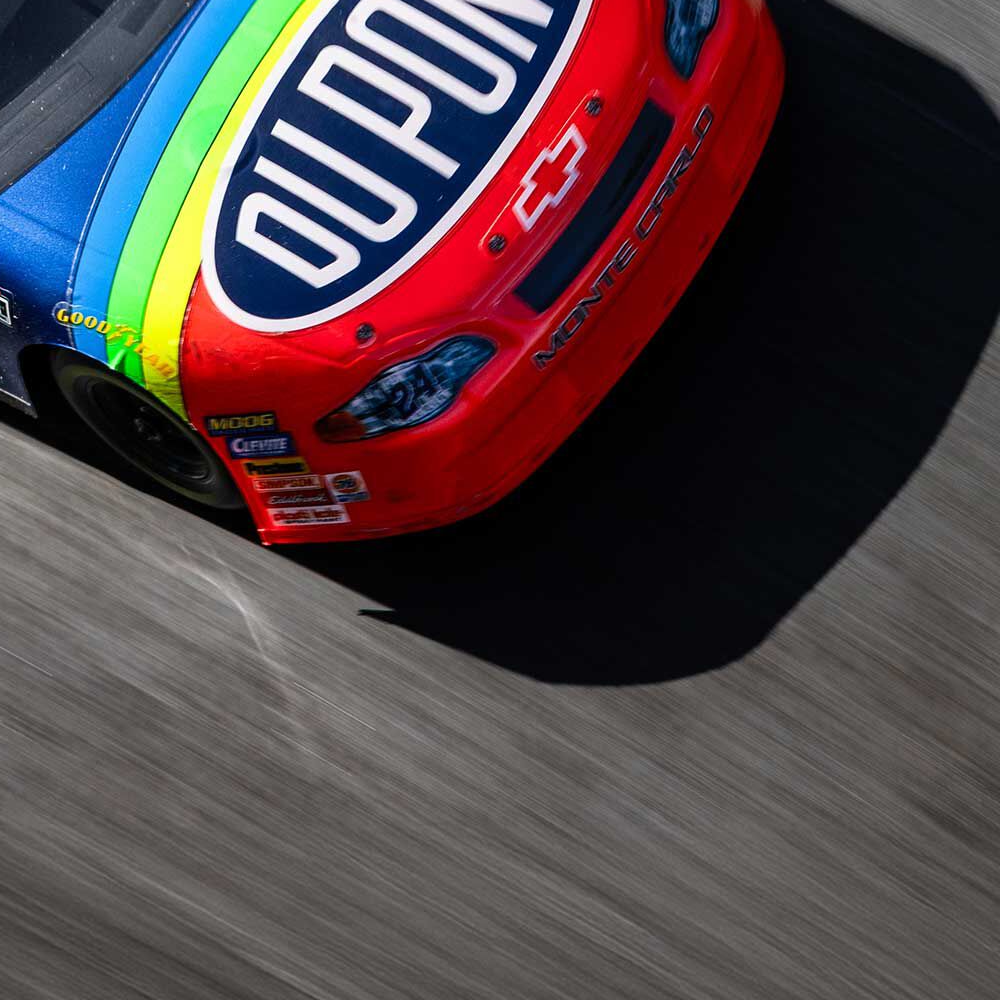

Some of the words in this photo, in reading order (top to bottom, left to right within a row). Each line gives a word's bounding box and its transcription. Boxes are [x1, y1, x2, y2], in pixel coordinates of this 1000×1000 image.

[531, 238, 639, 371] MONTE
[633, 103, 714, 241] CARLO
[209, 413, 275, 430] MOOG
